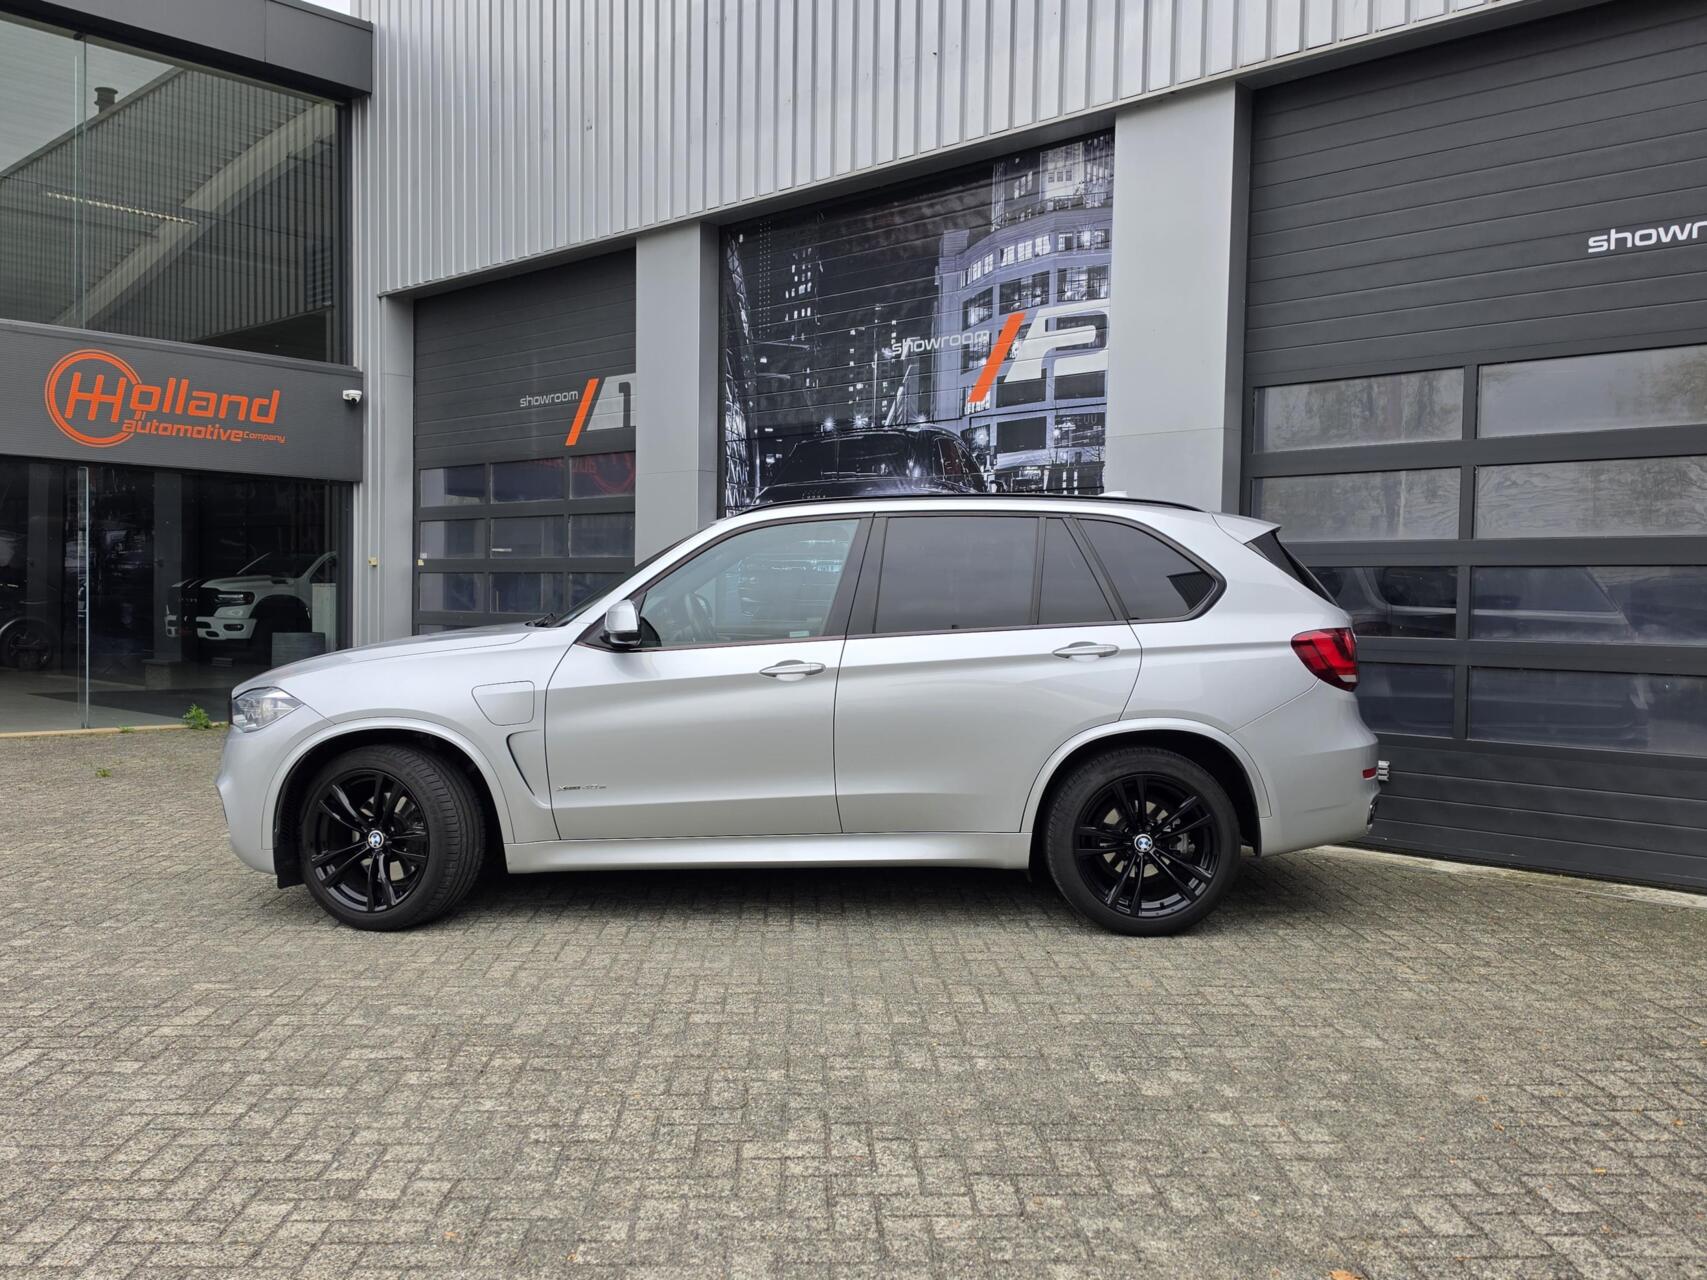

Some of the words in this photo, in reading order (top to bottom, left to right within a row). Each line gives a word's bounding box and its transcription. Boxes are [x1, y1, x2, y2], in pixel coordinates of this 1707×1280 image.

[891, 329, 990, 355] showroom
[519, 390, 579, 407] showroom
[122, 419, 243, 442] automotive
